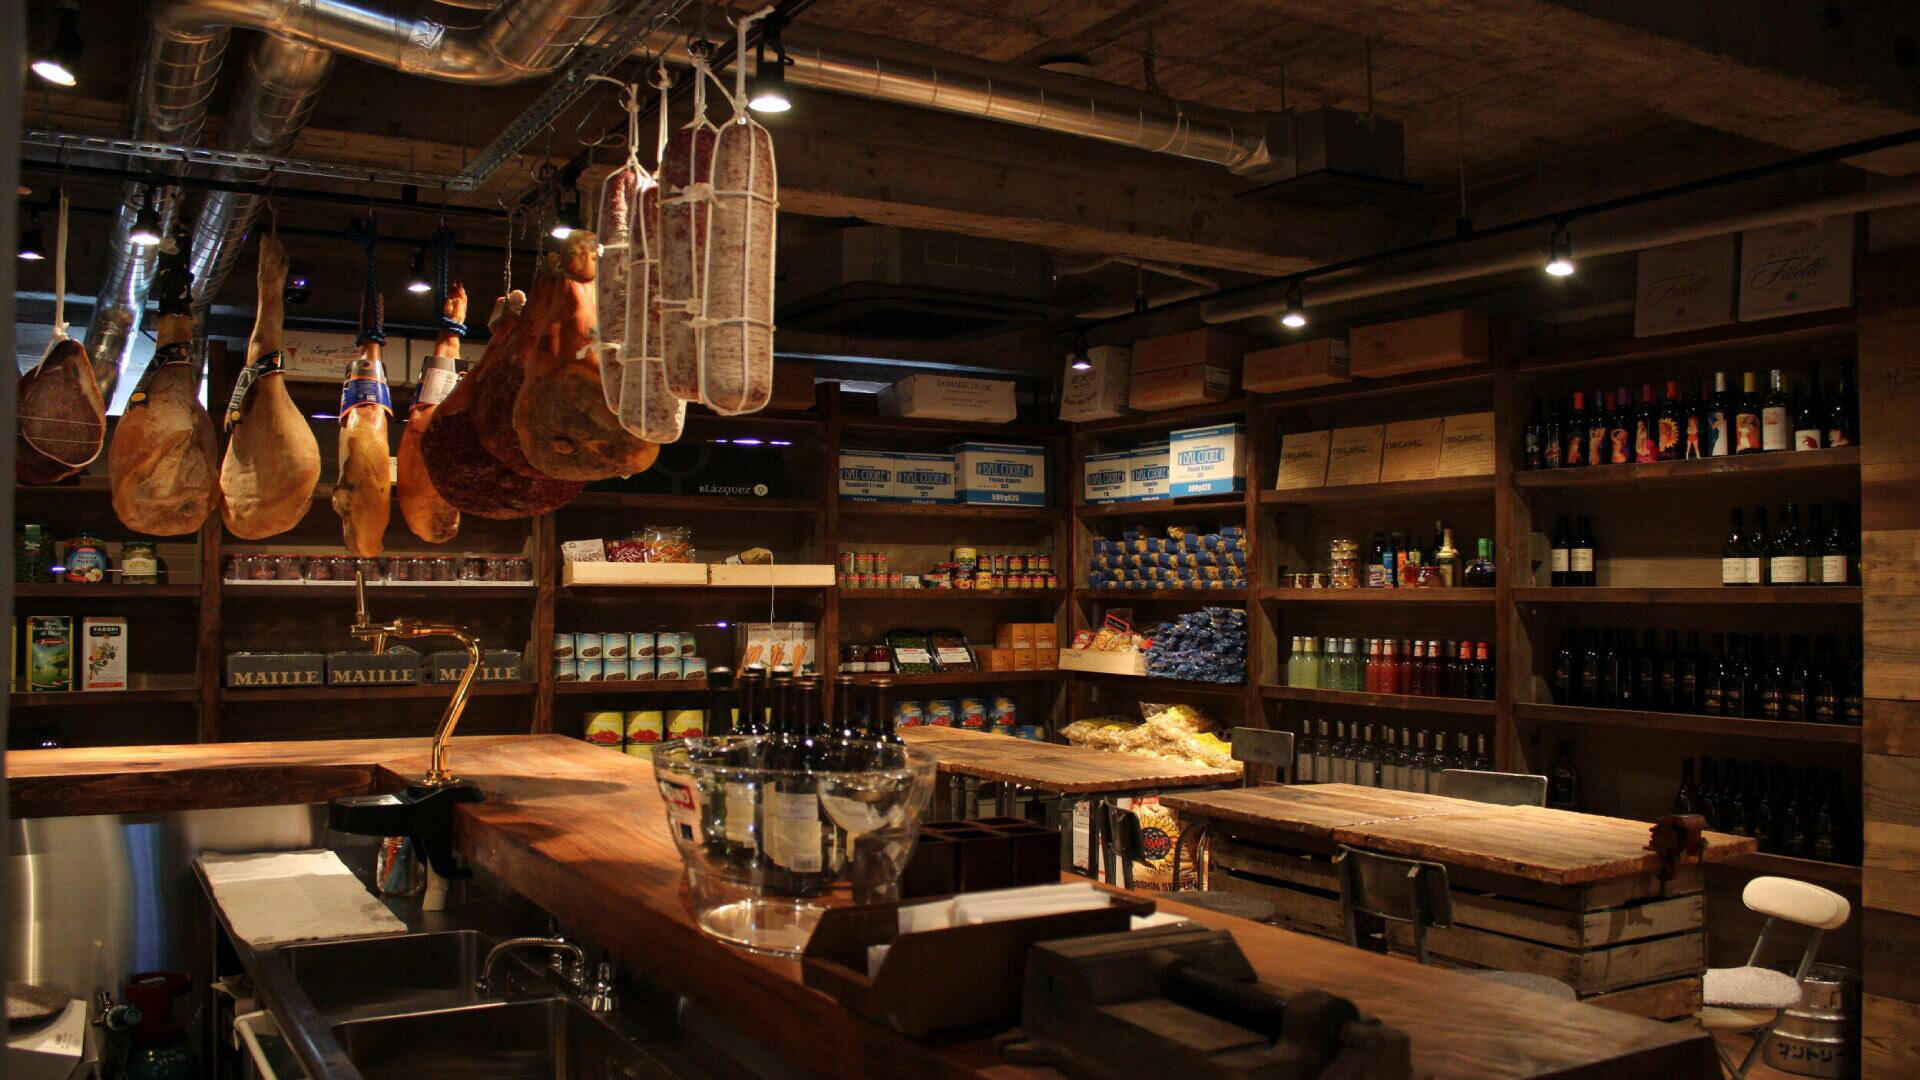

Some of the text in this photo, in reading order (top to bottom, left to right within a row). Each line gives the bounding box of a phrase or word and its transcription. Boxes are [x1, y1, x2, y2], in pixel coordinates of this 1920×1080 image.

[1385, 439, 1423, 450] ORGANIC
[1444, 433, 1483, 444] ORGANIC
[234, 671, 319, 686] MAILLE
[333, 669, 415, 683] MAILLE
[439, 667, 519, 681] MLLE
[1133, 880, 1160, 892] SSHIN
